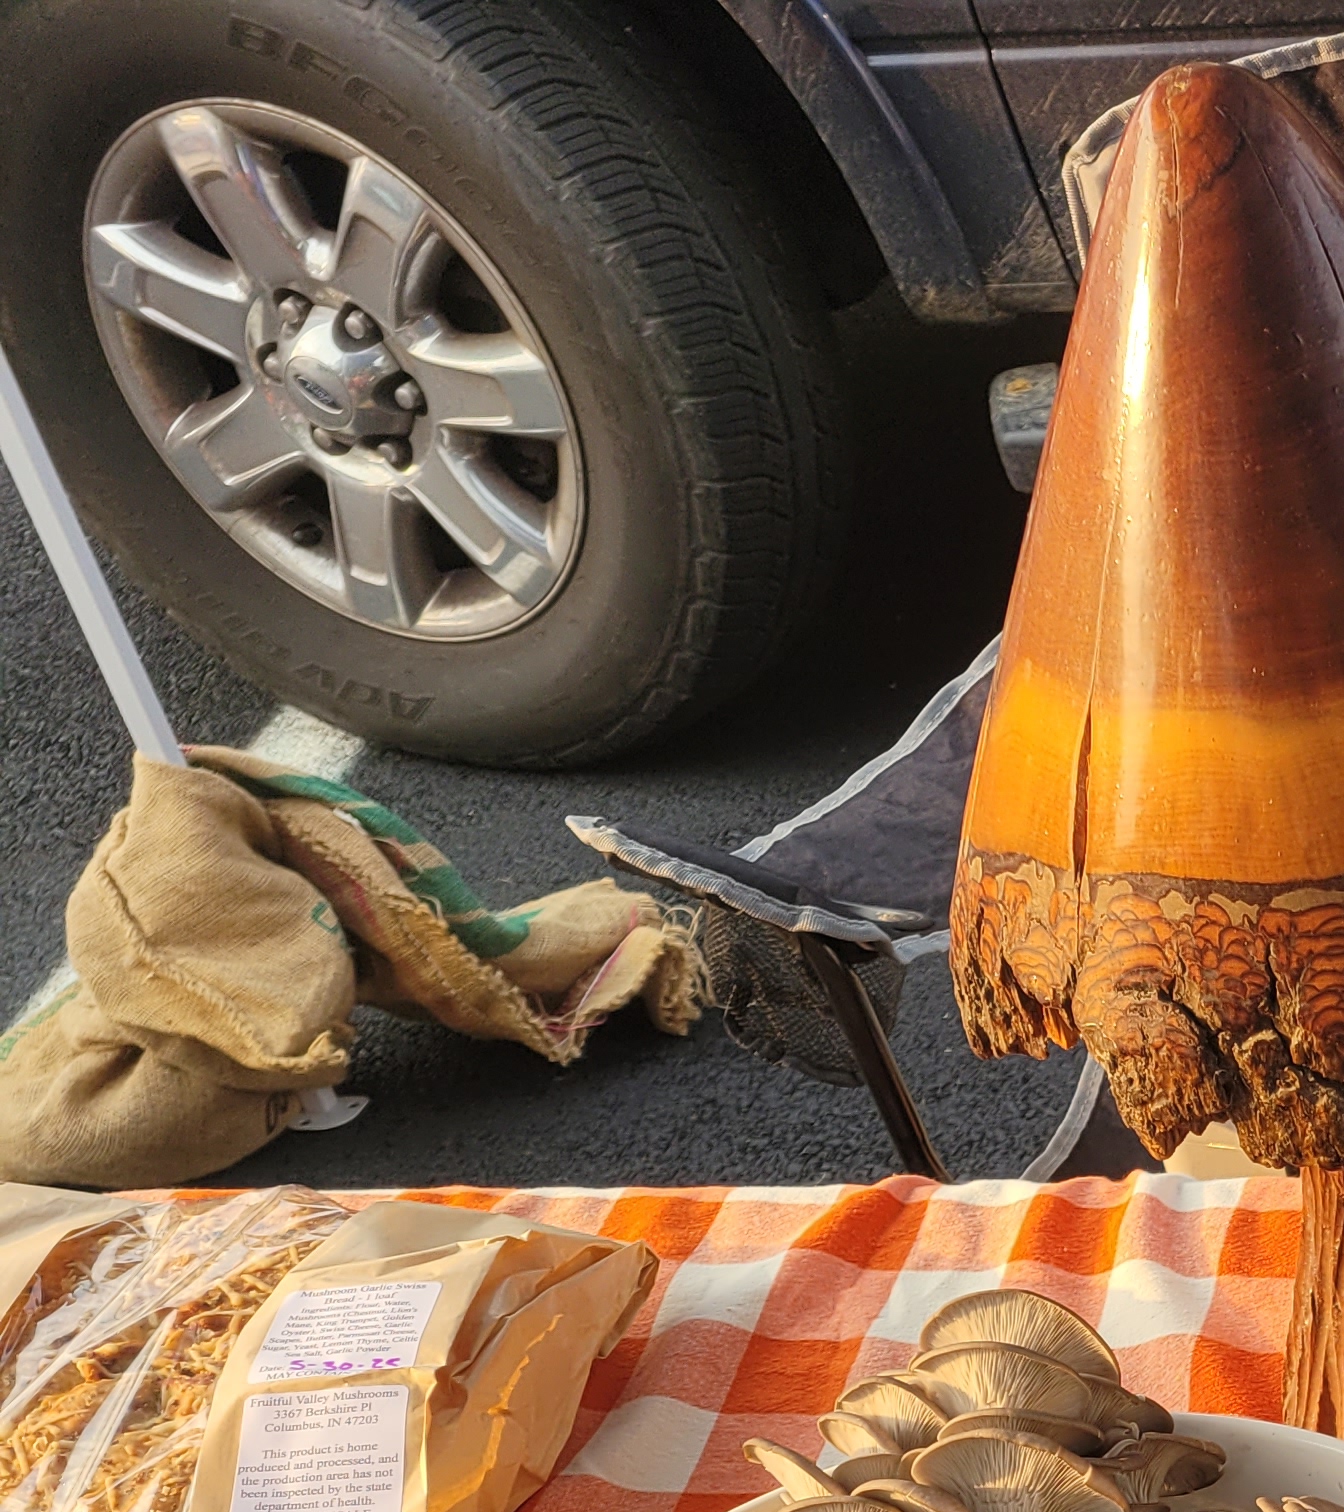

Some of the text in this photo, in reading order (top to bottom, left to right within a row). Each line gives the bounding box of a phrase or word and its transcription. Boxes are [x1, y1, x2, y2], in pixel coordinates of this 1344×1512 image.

[300, 1288, 357, 1298] Mushroom
[360, 1284, 393, 1292] Garlic
[324, 1295, 355, 1304] Bread
[374, 1291, 398, 1300] loaf
[300, 1304, 352, 1313] Ingredients:
[288, 1313, 341, 1321] Mushrooms
[337, 1331, 381, 1339] Parmesan
[322, 1340, 354, 1348] Lemon
[326, 1347, 354, 1355] Garlic
[266, 1371, 294, 1380] MAY
[250, 1389, 399, 1408] Fruitful Valley Mushrooms
[273, 1401, 372, 1420] 3367 Berkshire Pl
[264, 1414, 379, 1433] Columbus, IN 47203
[261, 1442, 379, 1460] This product is home
[237, 1452, 399, 1475] produced and processed, and
[241, 1468, 393, 1487] the production area has not
[240, 1482, 393, 1499] been inspected by the state
[254, 1495, 375, 1512] department of health.
